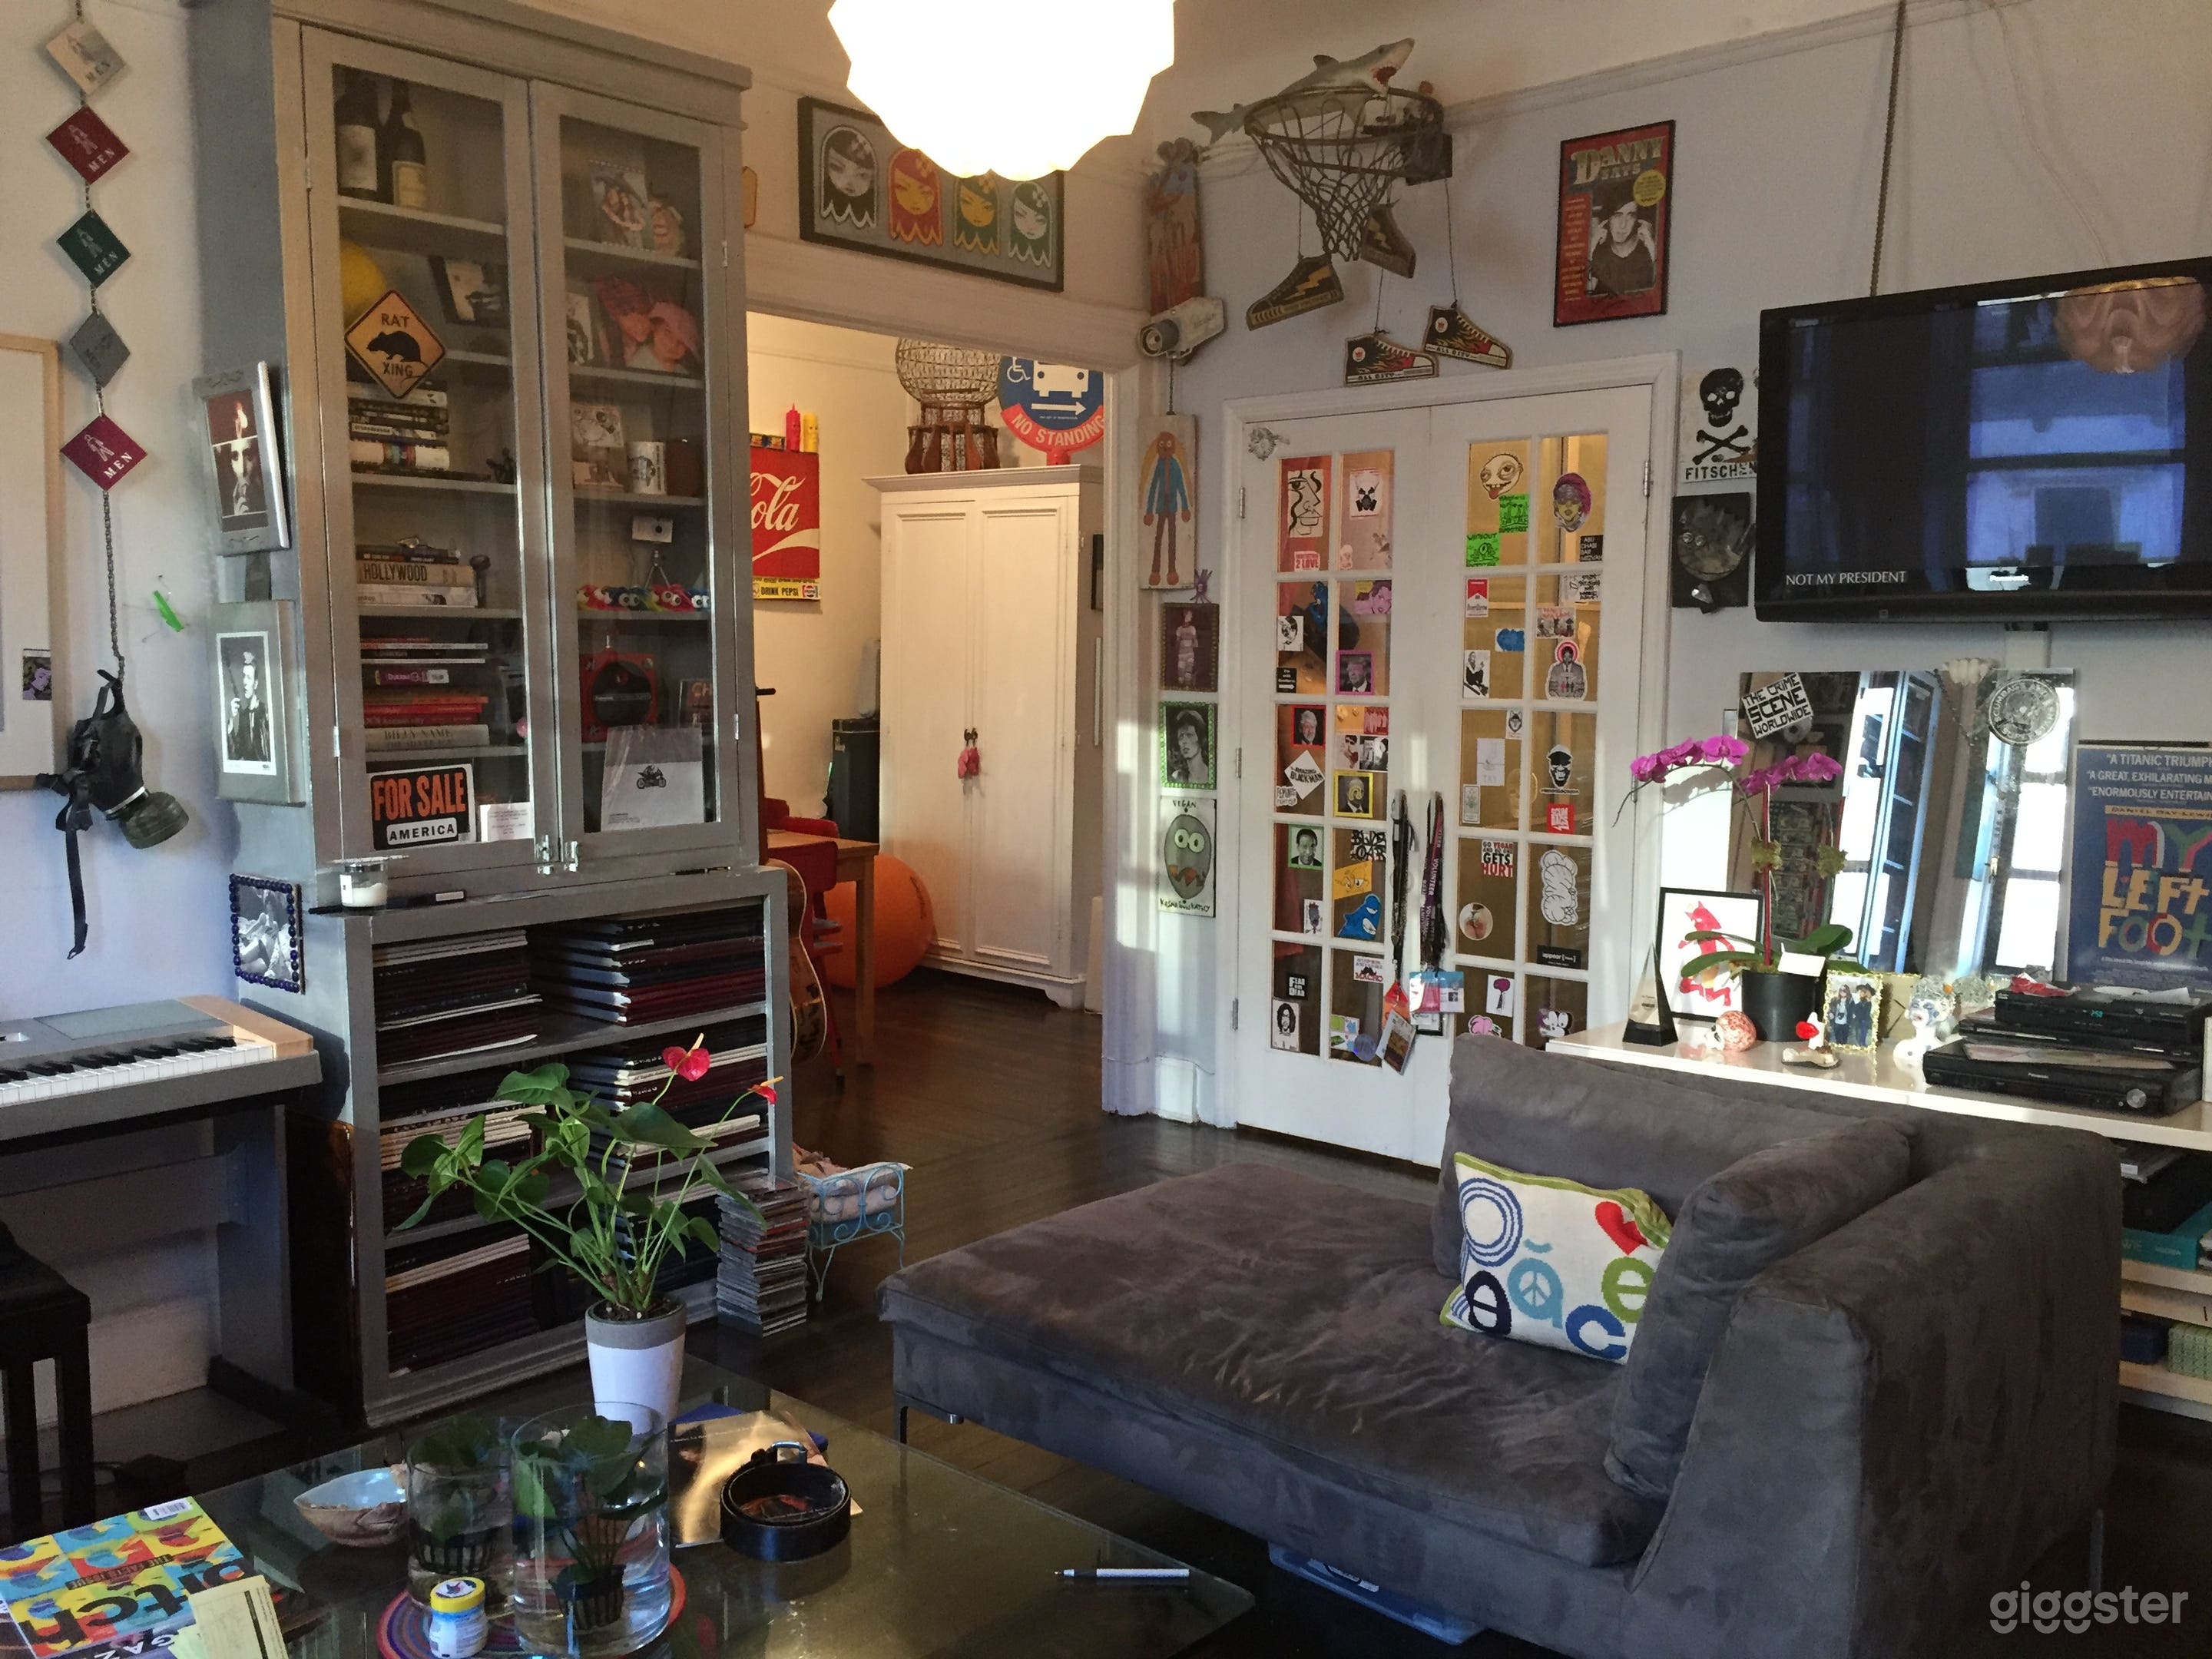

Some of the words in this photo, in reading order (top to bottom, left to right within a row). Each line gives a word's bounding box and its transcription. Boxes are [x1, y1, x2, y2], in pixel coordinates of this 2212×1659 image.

[88, 148, 116, 174] MEN
[1571, 137, 1665, 185] DANNY
[94, 250, 118, 276] MEN
[381, 313, 410, 328] RAT
[382, 361, 414, 377] XING
[1011, 412, 1033, 436] NO
[1035, 414, 1104, 446] STANDING
[104, 452, 134, 479] MEN
[363, 563, 429, 582] HOLLYWOOD
[1302, 558, 1320, 568] LOVE
[1786, 573, 1813, 586] NOT
[1816, 572, 1835, 585] MY
[1839, 571, 1906, 584] PRESIDENT
[781, 587, 799, 597] PEPSI
[1743, 688, 1767, 707] THE
[1767, 674, 1800, 696] CRIME
[1747, 686, 1807, 725] SCENE
[1753, 704, 1812, 737] WORLDWIDE
[2120, 753, 2162, 767] TITANIC
[2131, 772, 2203, 784] EXHILARATING
[373, 777, 413, 821] FOR
[416, 771, 466, 818] SALE
[1173, 800, 1197, 808] VEGAN
[389, 823, 455, 842] AMERICA
[2104, 818, 2212, 873] MY
[1483, 852, 1511, 866] GETS
[1481, 863, 1514, 878] HURT
